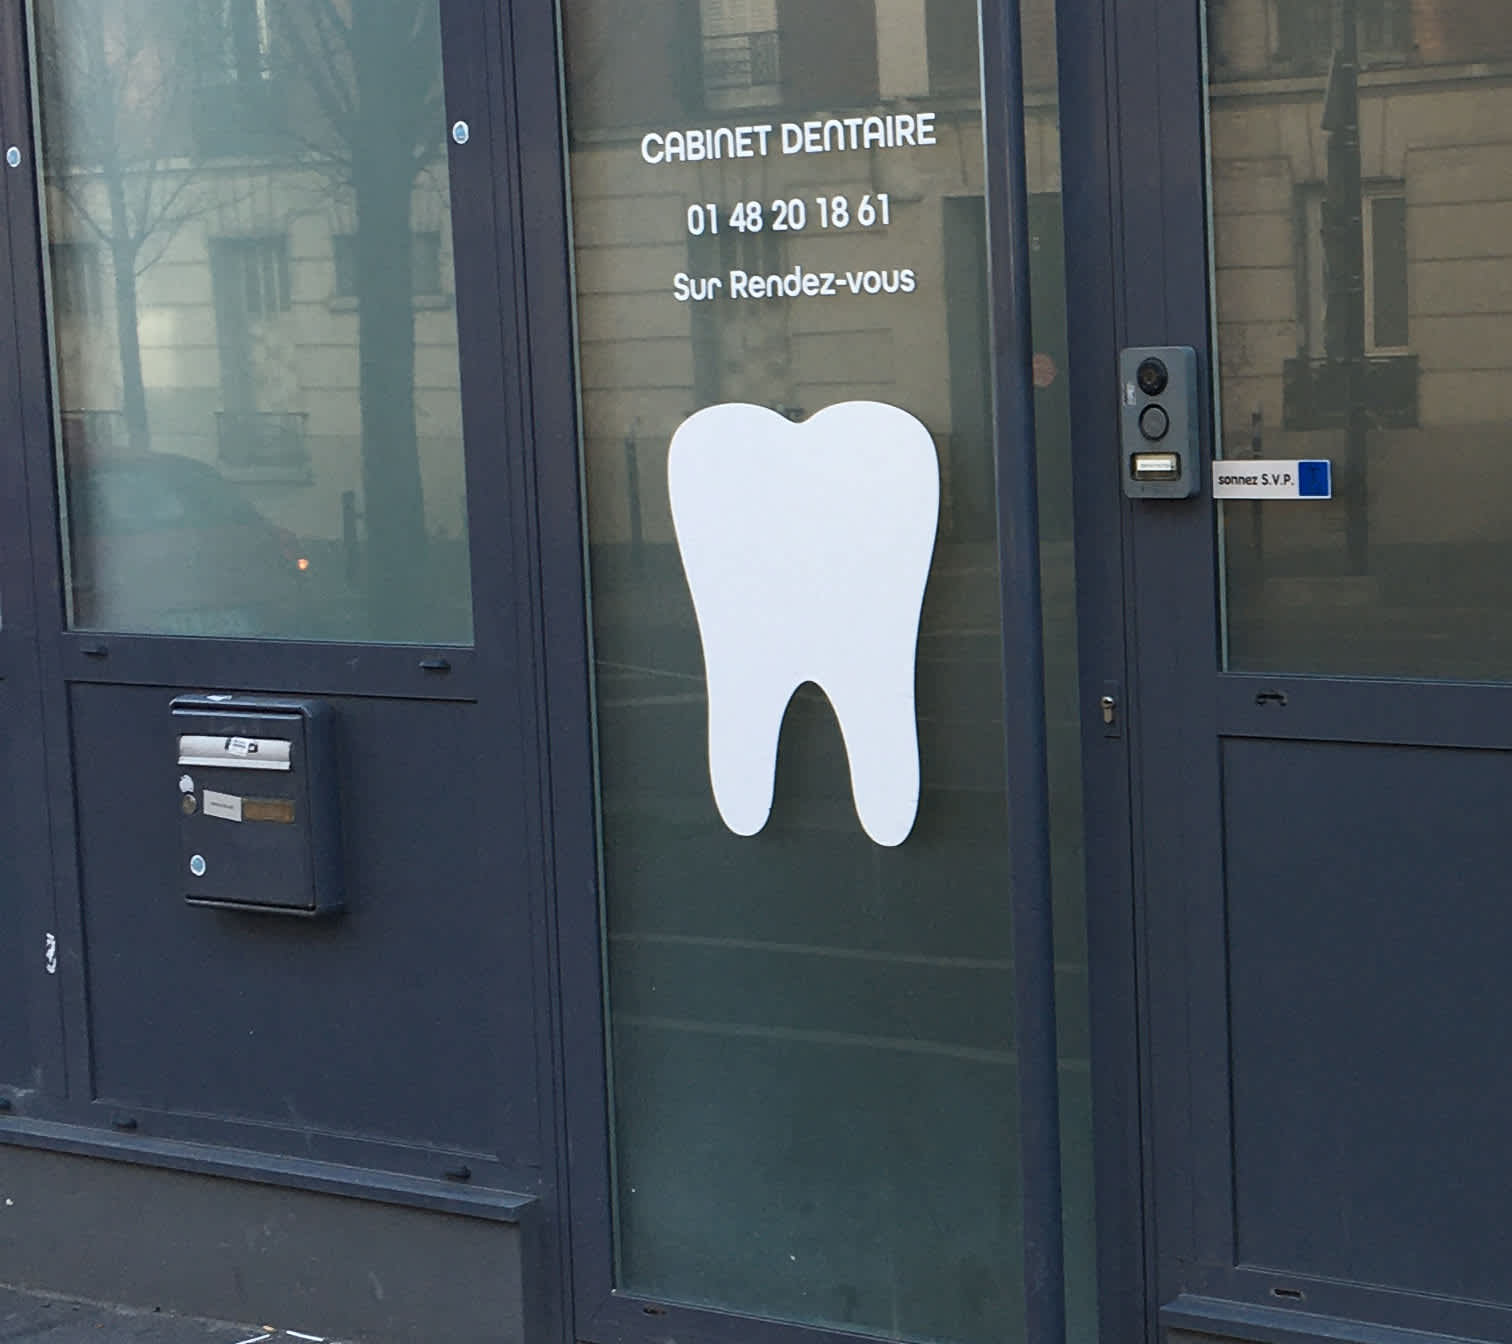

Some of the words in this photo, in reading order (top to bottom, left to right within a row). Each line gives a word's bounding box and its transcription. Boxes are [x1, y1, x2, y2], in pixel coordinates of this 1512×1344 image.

[641, 124, 772, 164] CABINET
[781, 112, 937, 155] DENTAIRE
[687, 203, 718, 235] 01
[729, 201, 763, 233] 48
[772, 198, 806, 231] 20
[816, 195, 849, 228] 18
[857, 193, 890, 226] 61
[673, 272, 722, 301] Sur
[729, 265, 916, 299] Rendez-vous
[1218, 475, 1258, 486] sonnez
[1261, 474, 1295, 487] S.V.P.
